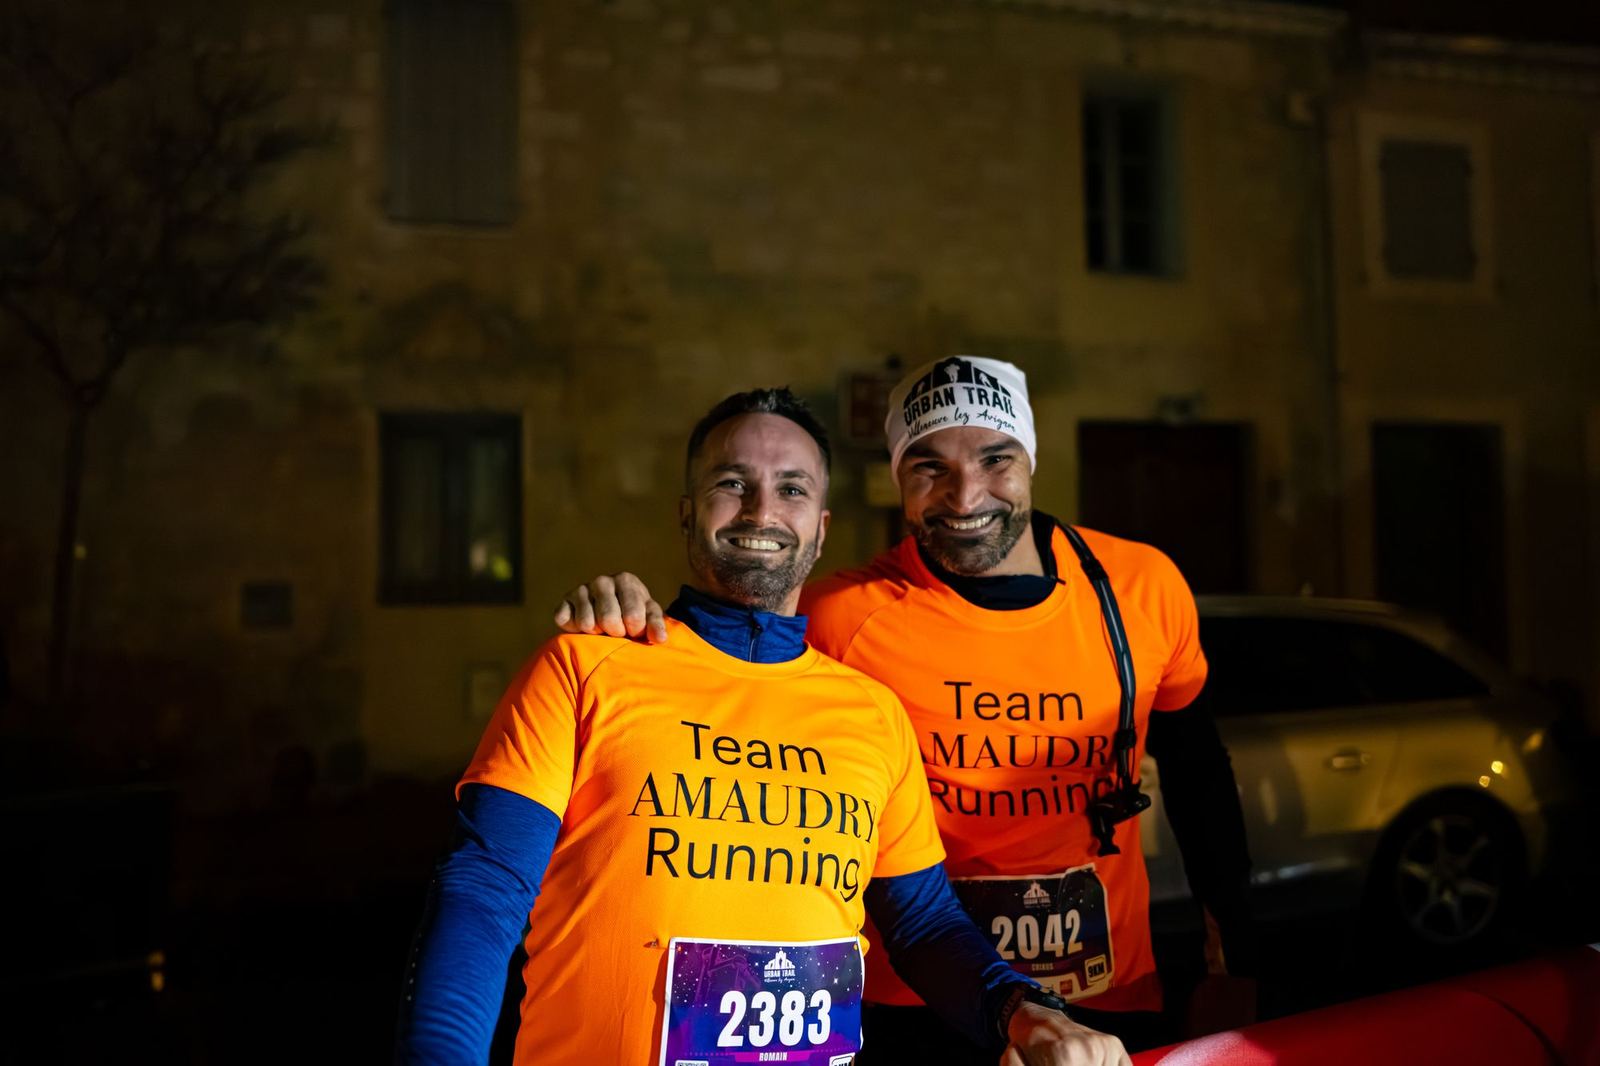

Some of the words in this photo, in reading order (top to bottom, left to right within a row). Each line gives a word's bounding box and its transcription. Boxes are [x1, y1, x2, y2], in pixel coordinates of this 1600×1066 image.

[904, 387, 955, 426] URBAN
[963, 386, 1016, 418] TRAIL
[944, 681, 1083, 721] Team
[681, 720, 826, 775] Team
[627, 771, 877, 844] AMAUDRY
[645, 827, 860, 903] Running
[991, 909, 1083, 960] 2042
[717, 989, 832, 1047] 2383
[759, 1052, 788, 1062] ROMAIN
